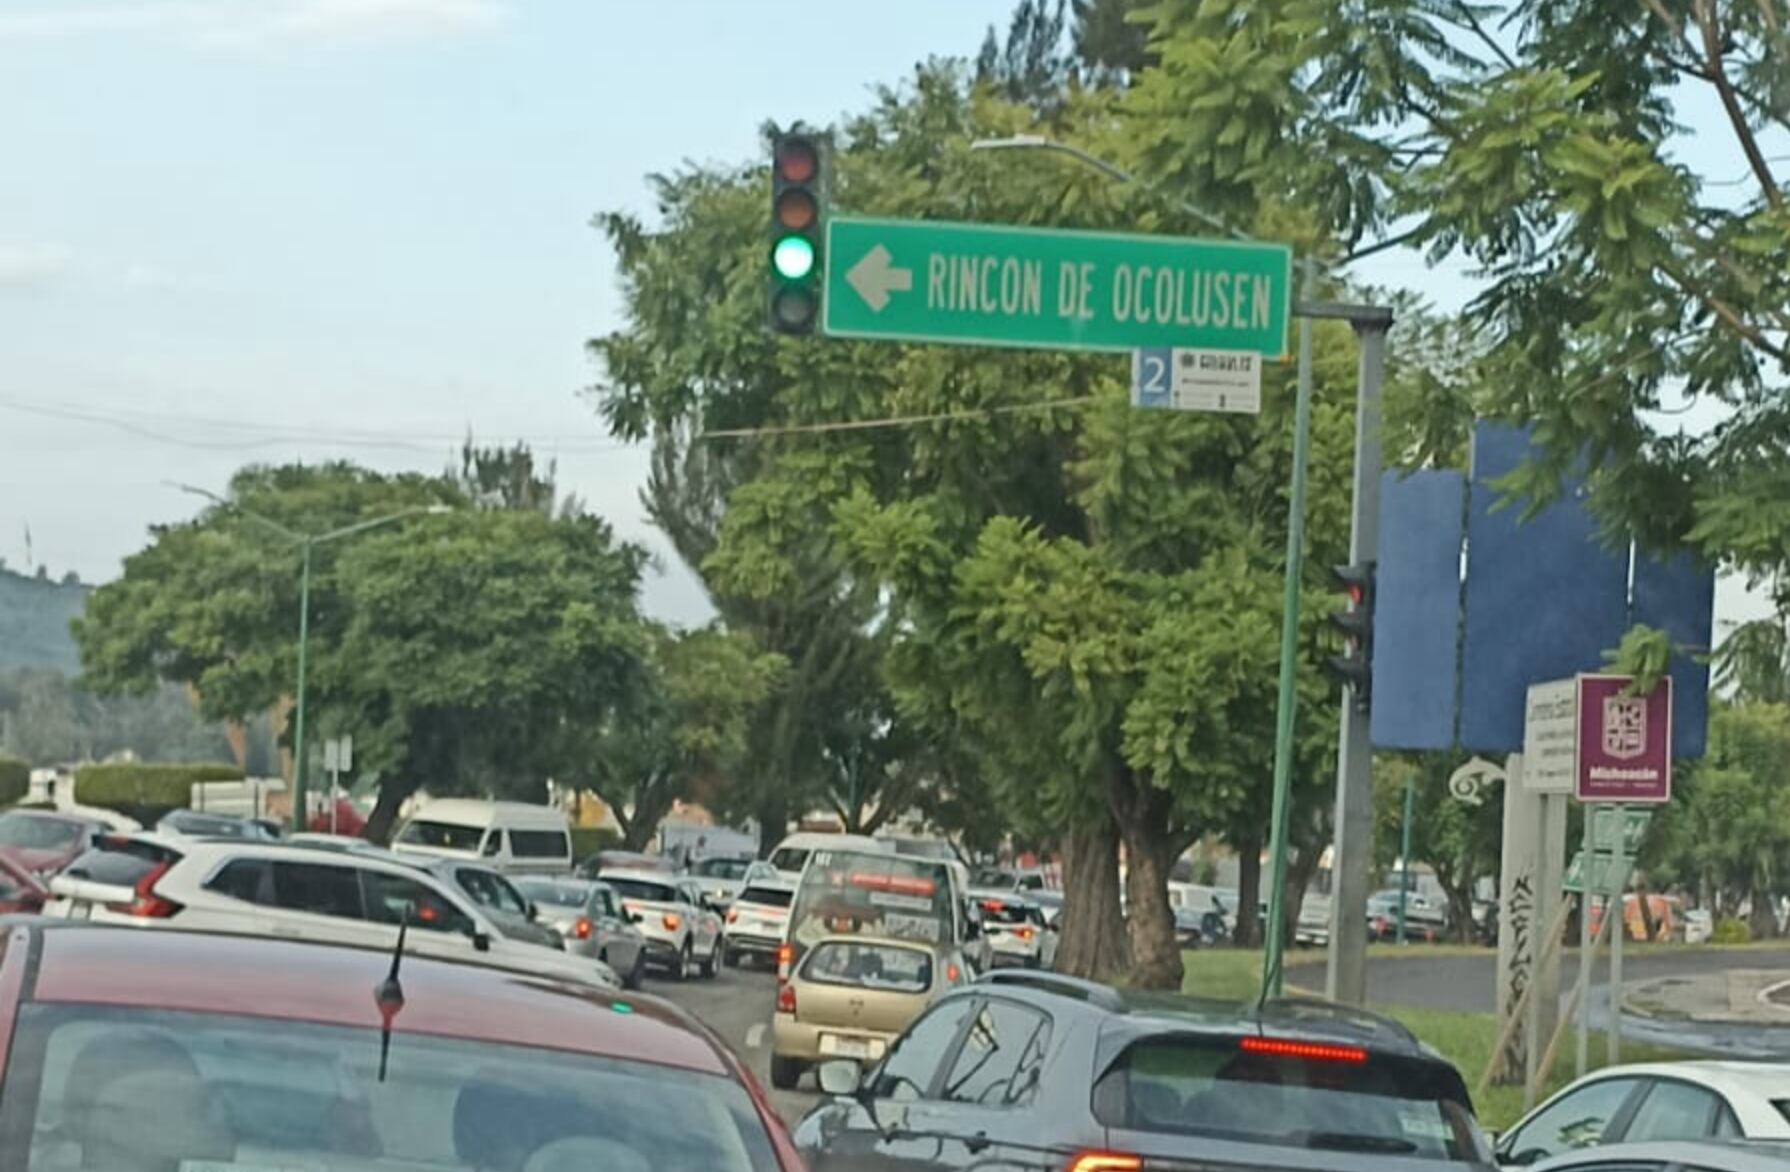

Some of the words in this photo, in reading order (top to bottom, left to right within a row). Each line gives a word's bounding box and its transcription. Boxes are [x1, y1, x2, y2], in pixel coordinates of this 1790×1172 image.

[926, 252, 1043, 315] RINCON
[1057, 261, 1097, 319] DE
[1111, 264, 1272, 331] OCOLUSEN
[1143, 356, 1166, 393] 2
